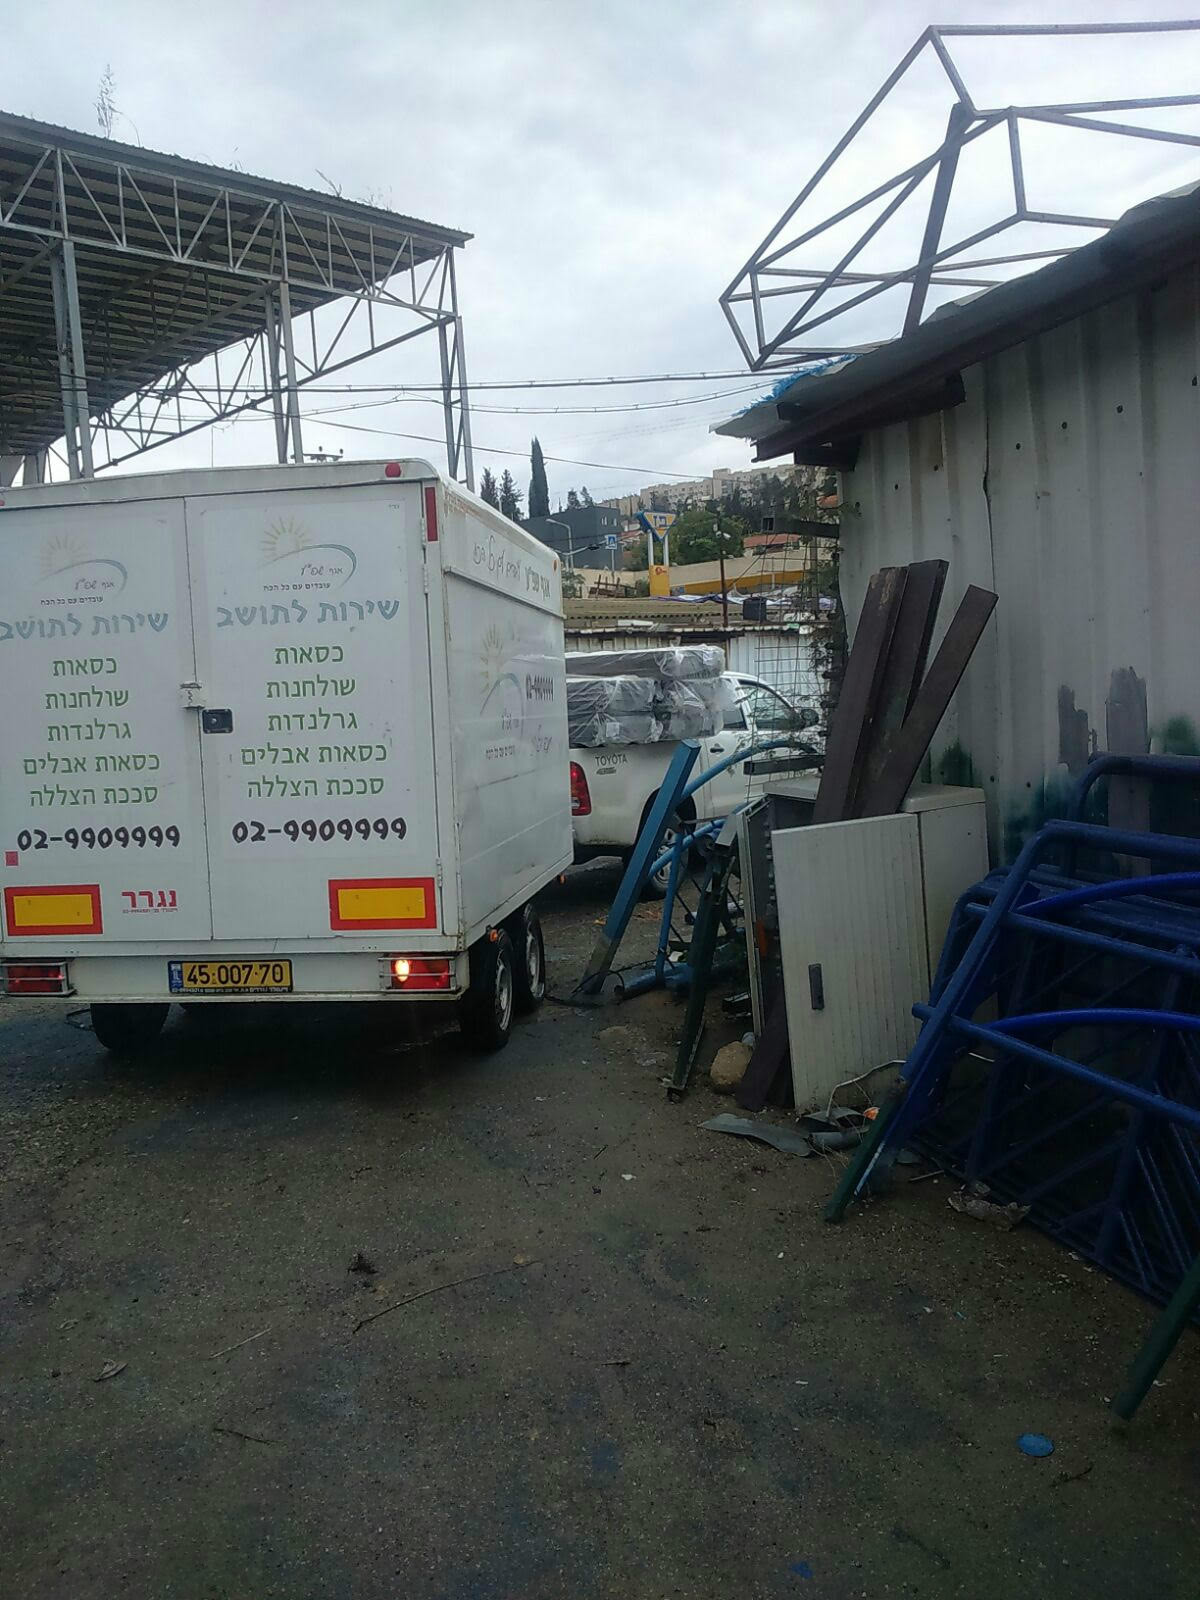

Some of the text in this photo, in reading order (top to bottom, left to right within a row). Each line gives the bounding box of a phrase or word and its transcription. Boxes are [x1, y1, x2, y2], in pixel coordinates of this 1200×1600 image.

[280, 583, 290, 591] כל
[305, 582, 331, 590] עובדים
[79, 596, 103, 604] עובדים
[216, 599, 399, 628] שירות לתושב
[0, 612, 169, 641] שירות לתושב
[52, 657, 117, 676] כסאות
[275, 645, 344, 665] כסאות
[45, 685, 129, 710] שולחנות
[266, 674, 356, 698] שולחנות
[47, 718, 132, 741] גרלנדות
[268, 707, 358, 731] גרלנדות
[23, 752, 160, 775] כסאות אבלים
[241, 742, 387, 766] כסאות אבלים
[594, 753, 628, 767] TOYOTA
[29, 784, 158, 807] סככת הצללה
[247, 775, 384, 798] סככת הצללה
[17, 825, 180, 851] 02-9909999
[232, 816, 407, 844] 02-9909999
[121, 890, 178, 908] נגרר
